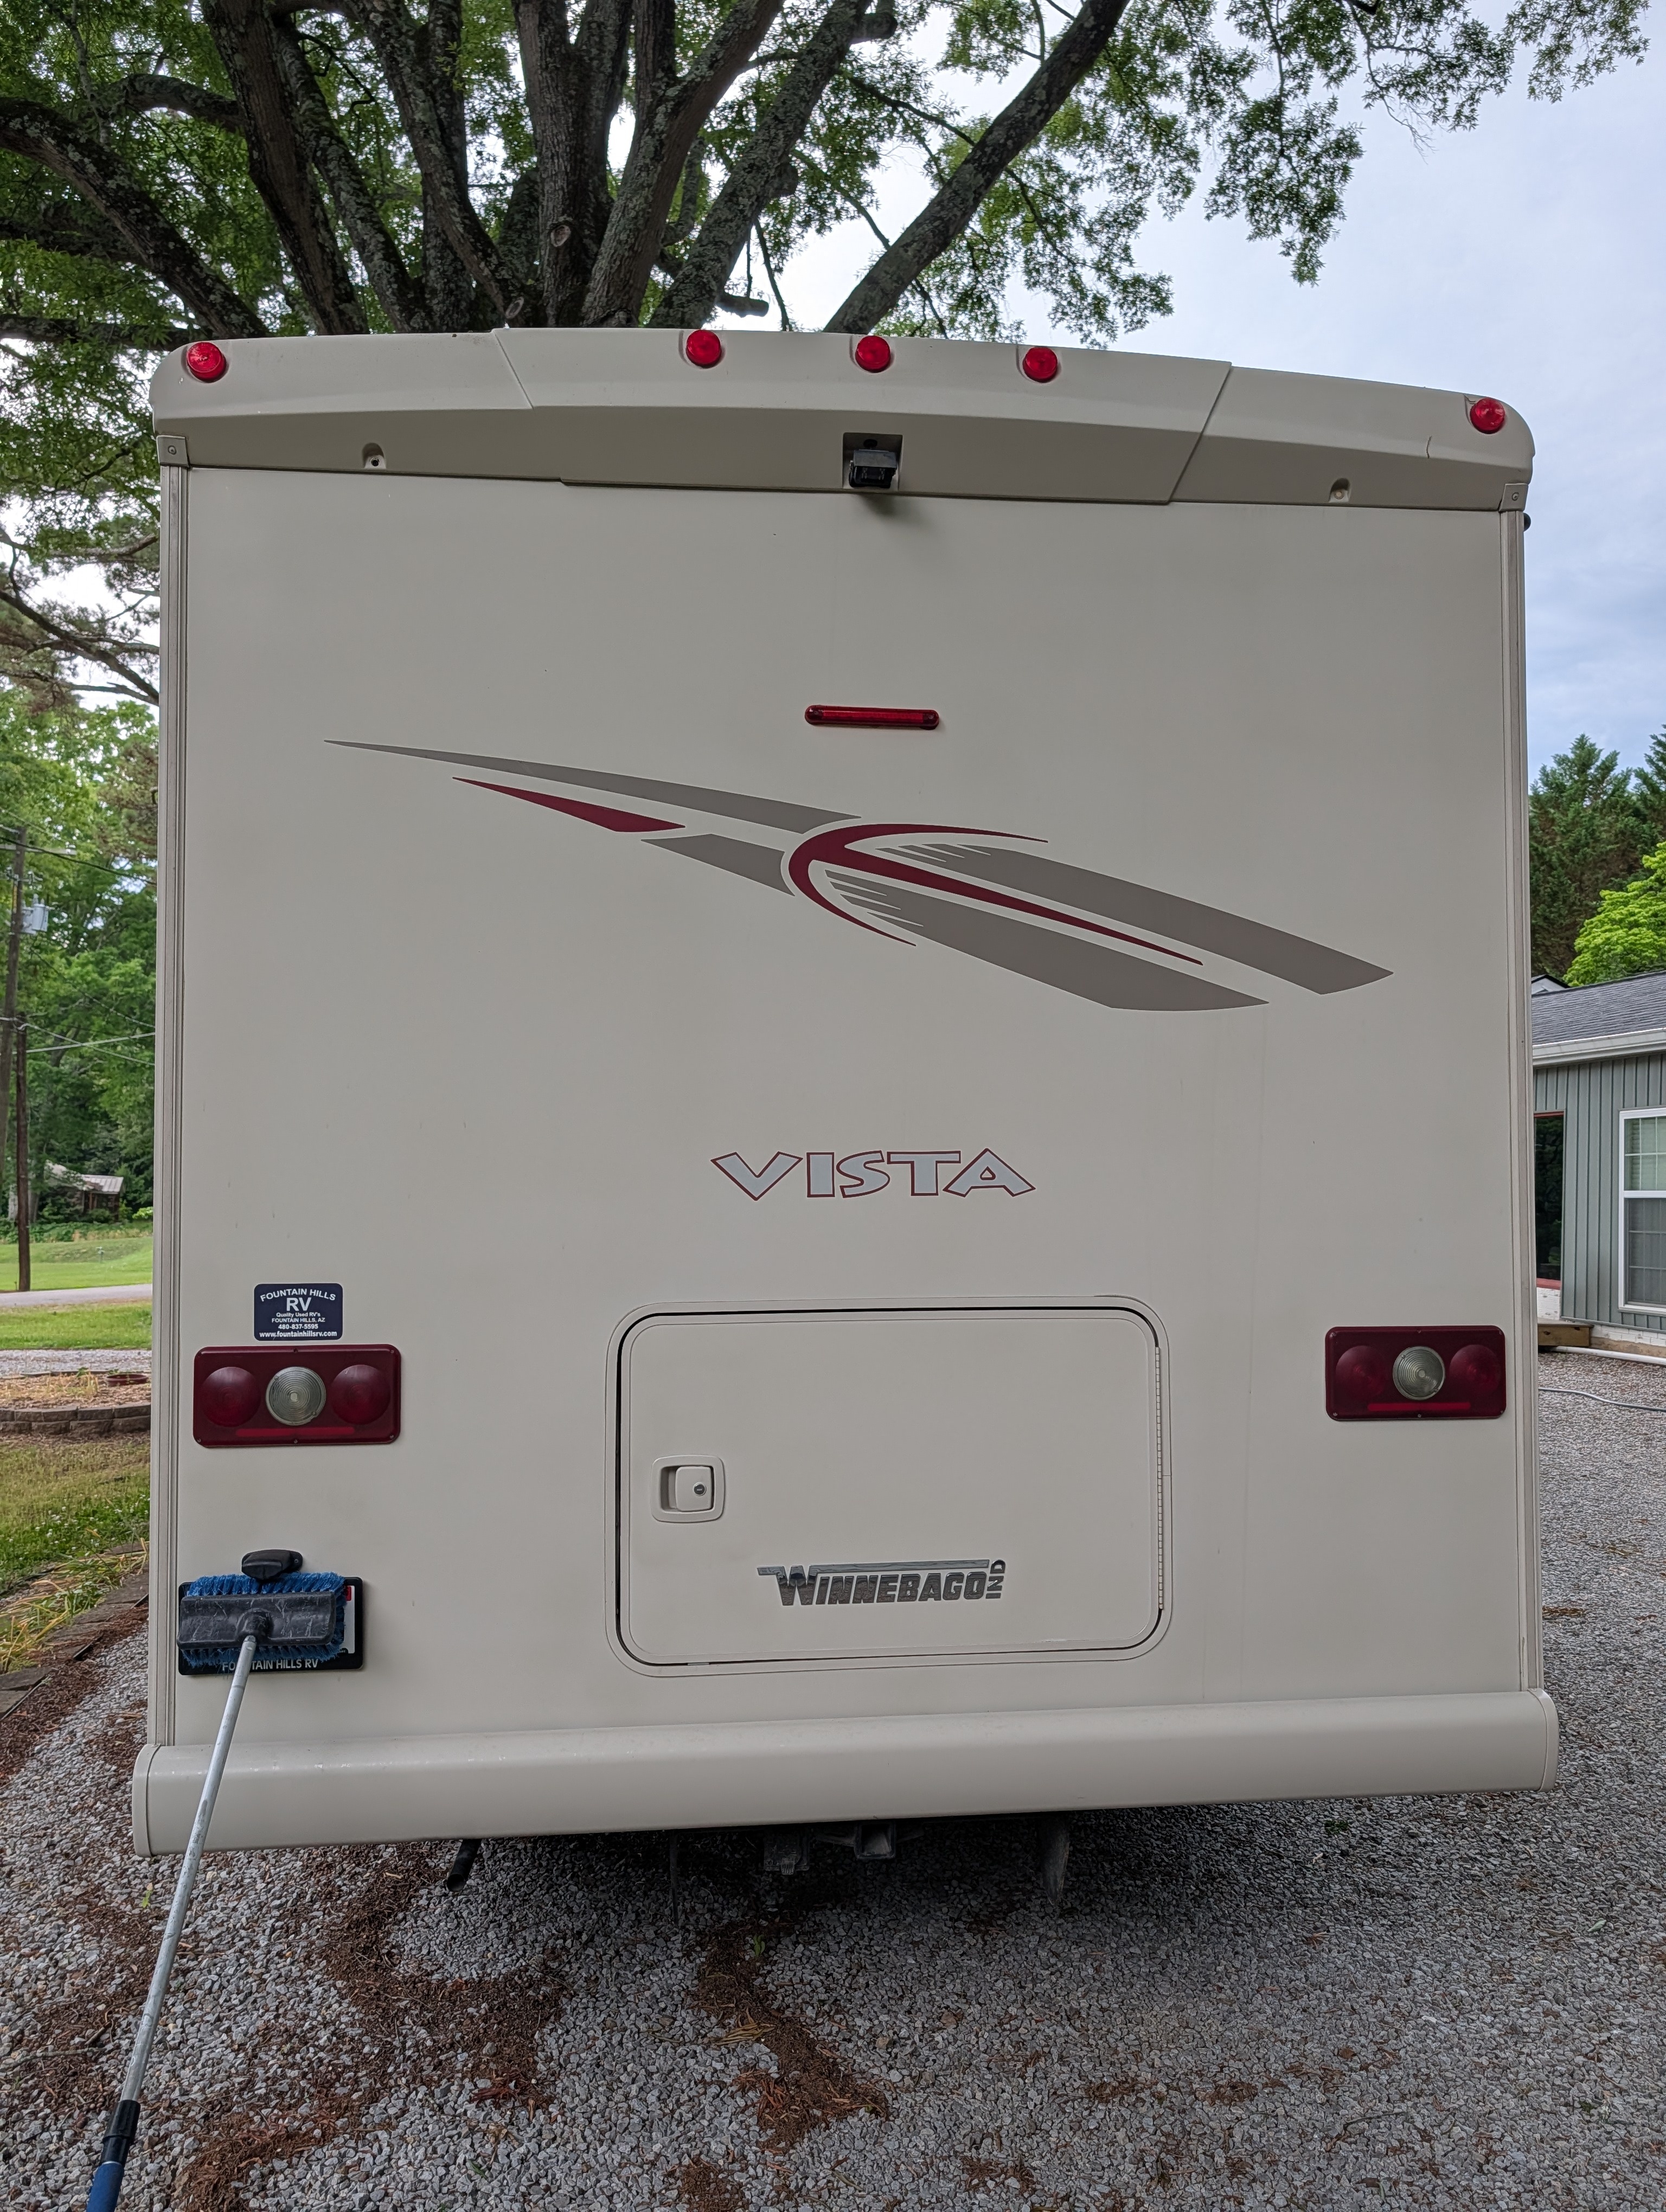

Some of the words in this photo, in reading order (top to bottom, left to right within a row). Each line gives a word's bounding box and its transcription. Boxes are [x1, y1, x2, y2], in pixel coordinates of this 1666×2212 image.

[710, 1148, 1036, 1201] VISTA
[260, 1288, 307, 1302] FOUNTAIN
[310, 1289, 336, 1301] HILLS
[286, 1297, 311, 1311] RV
[757, 1559, 990, 1606] WINNEBAGO
[222, 1660, 273, 1671] FOTAIN
[276, 1659, 302, 1669] HILLS
[305, 1658, 318, 1668] RV
